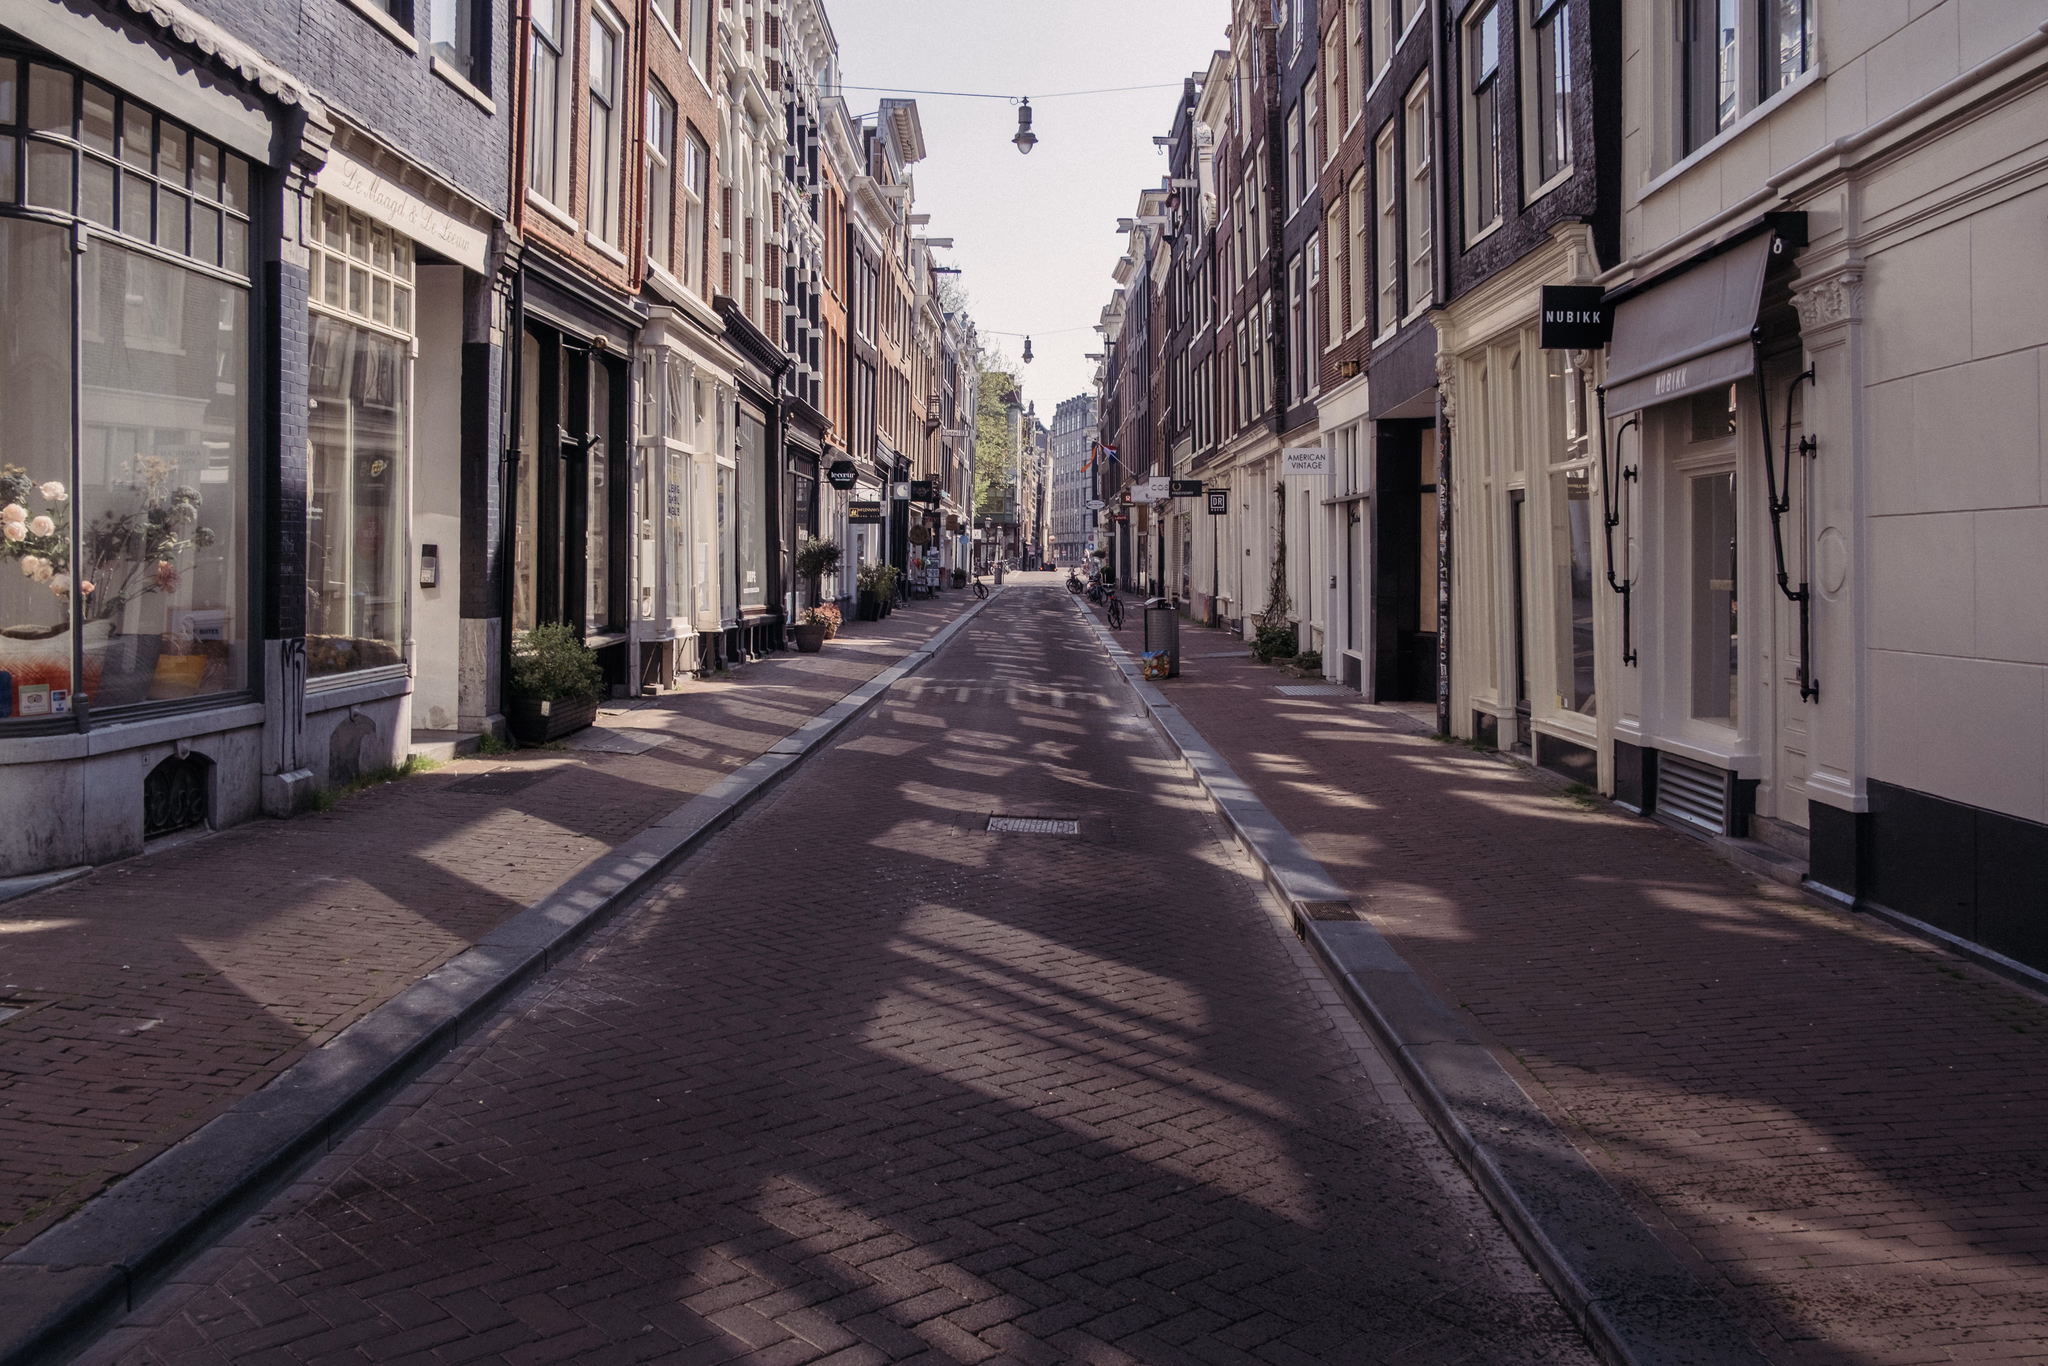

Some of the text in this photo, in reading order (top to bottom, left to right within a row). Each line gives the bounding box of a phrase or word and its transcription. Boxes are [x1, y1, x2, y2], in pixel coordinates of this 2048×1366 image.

[342, 159, 470, 251] De Maagd & De Leeuw
[1546, 311, 1601, 324] NUBIKK
[1655, 367, 1687, 396] NUBIKK
[1287, 453, 1326, 461] AMERICAN
[1291, 461, 1322, 469] VINTAGE
[1212, 497, 1223, 506] DR
